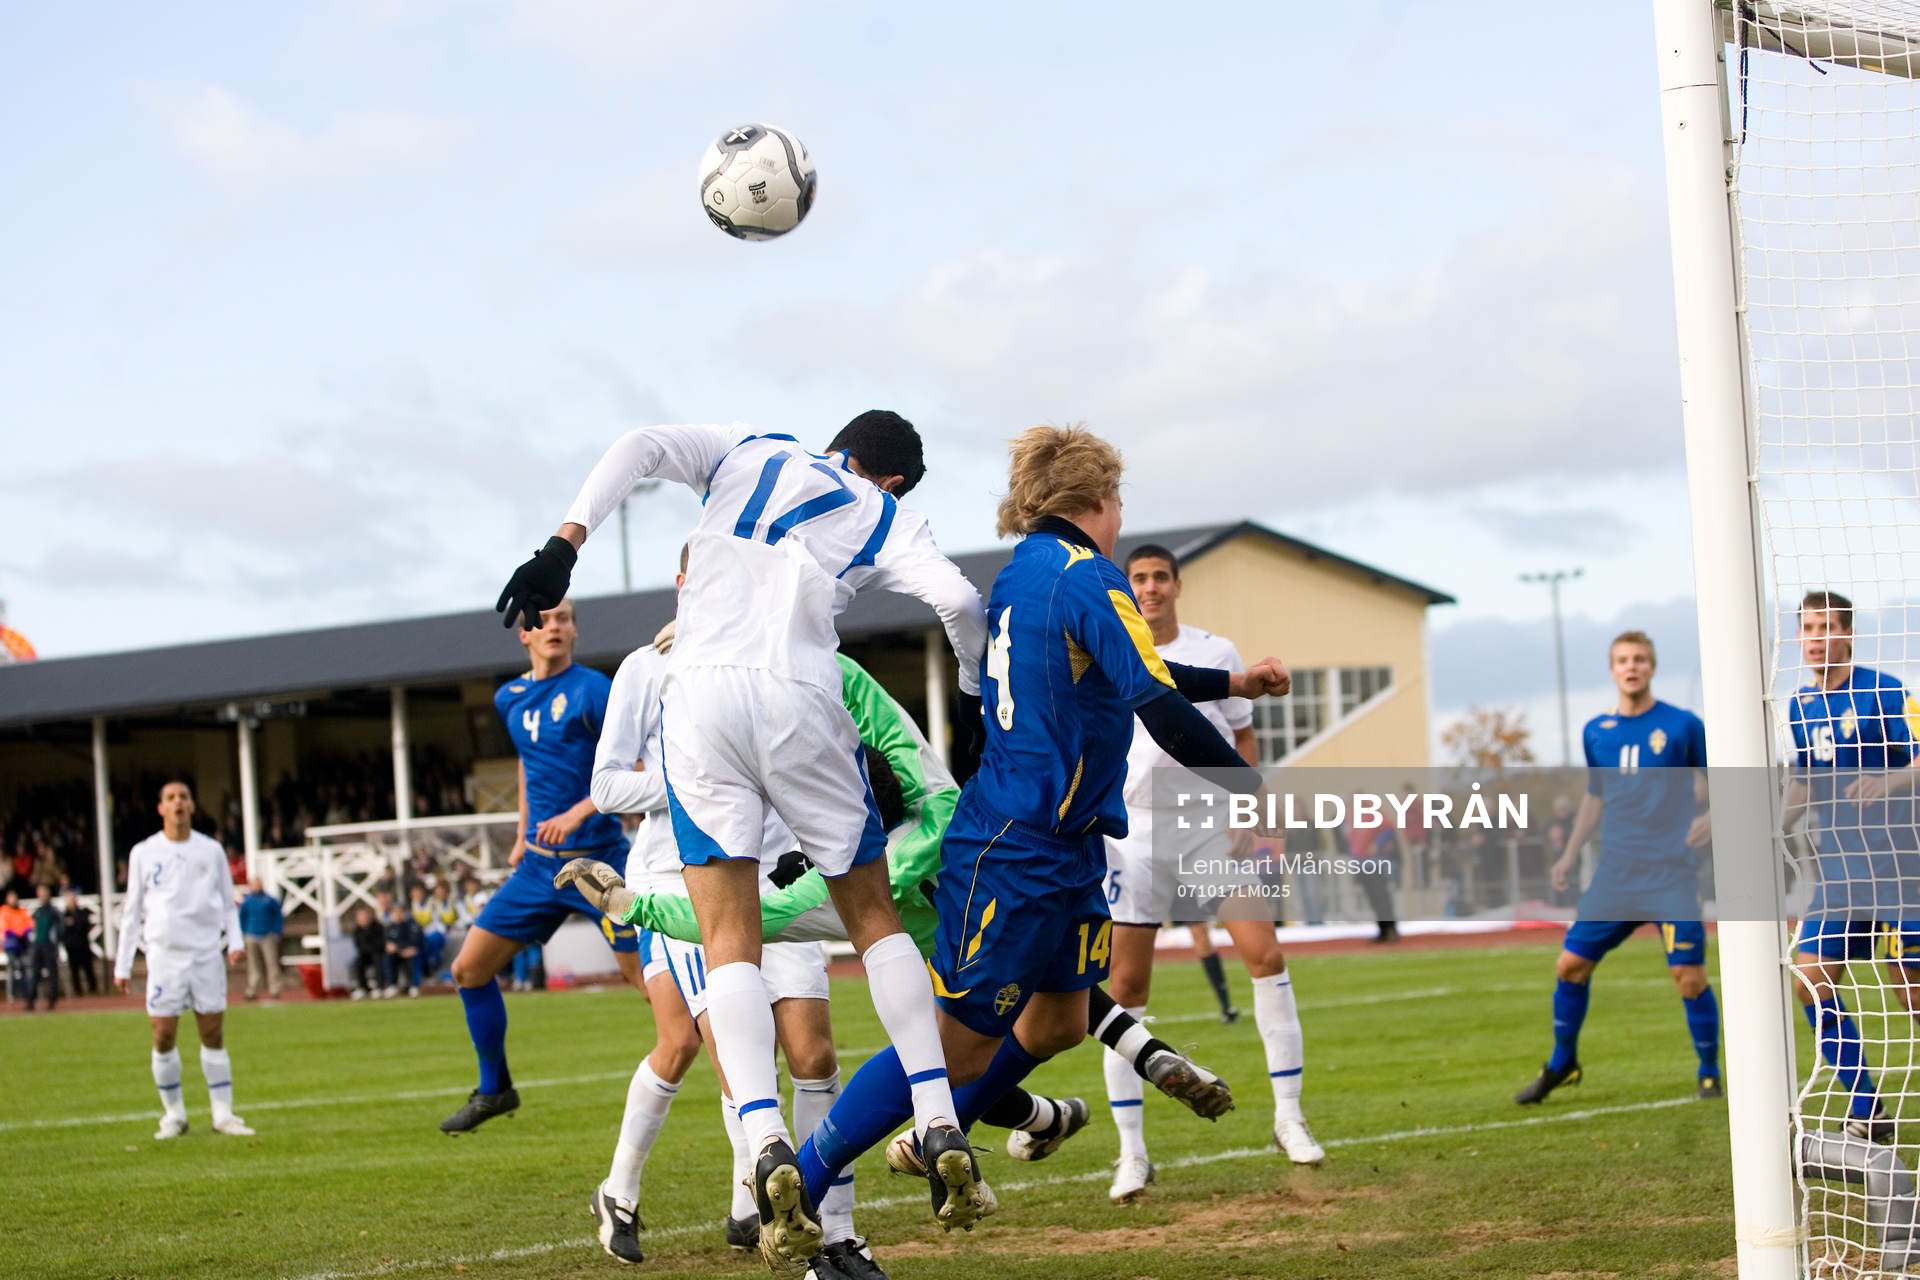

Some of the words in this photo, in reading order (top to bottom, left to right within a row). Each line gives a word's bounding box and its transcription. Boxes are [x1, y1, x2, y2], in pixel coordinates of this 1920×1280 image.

[522, 709, 540, 743] 4
[1619, 744, 1640, 775] 11
[153, 863, 162, 885] 2
[1108, 870, 1122, 904] 6
[1077, 920, 1113, 975] 14
